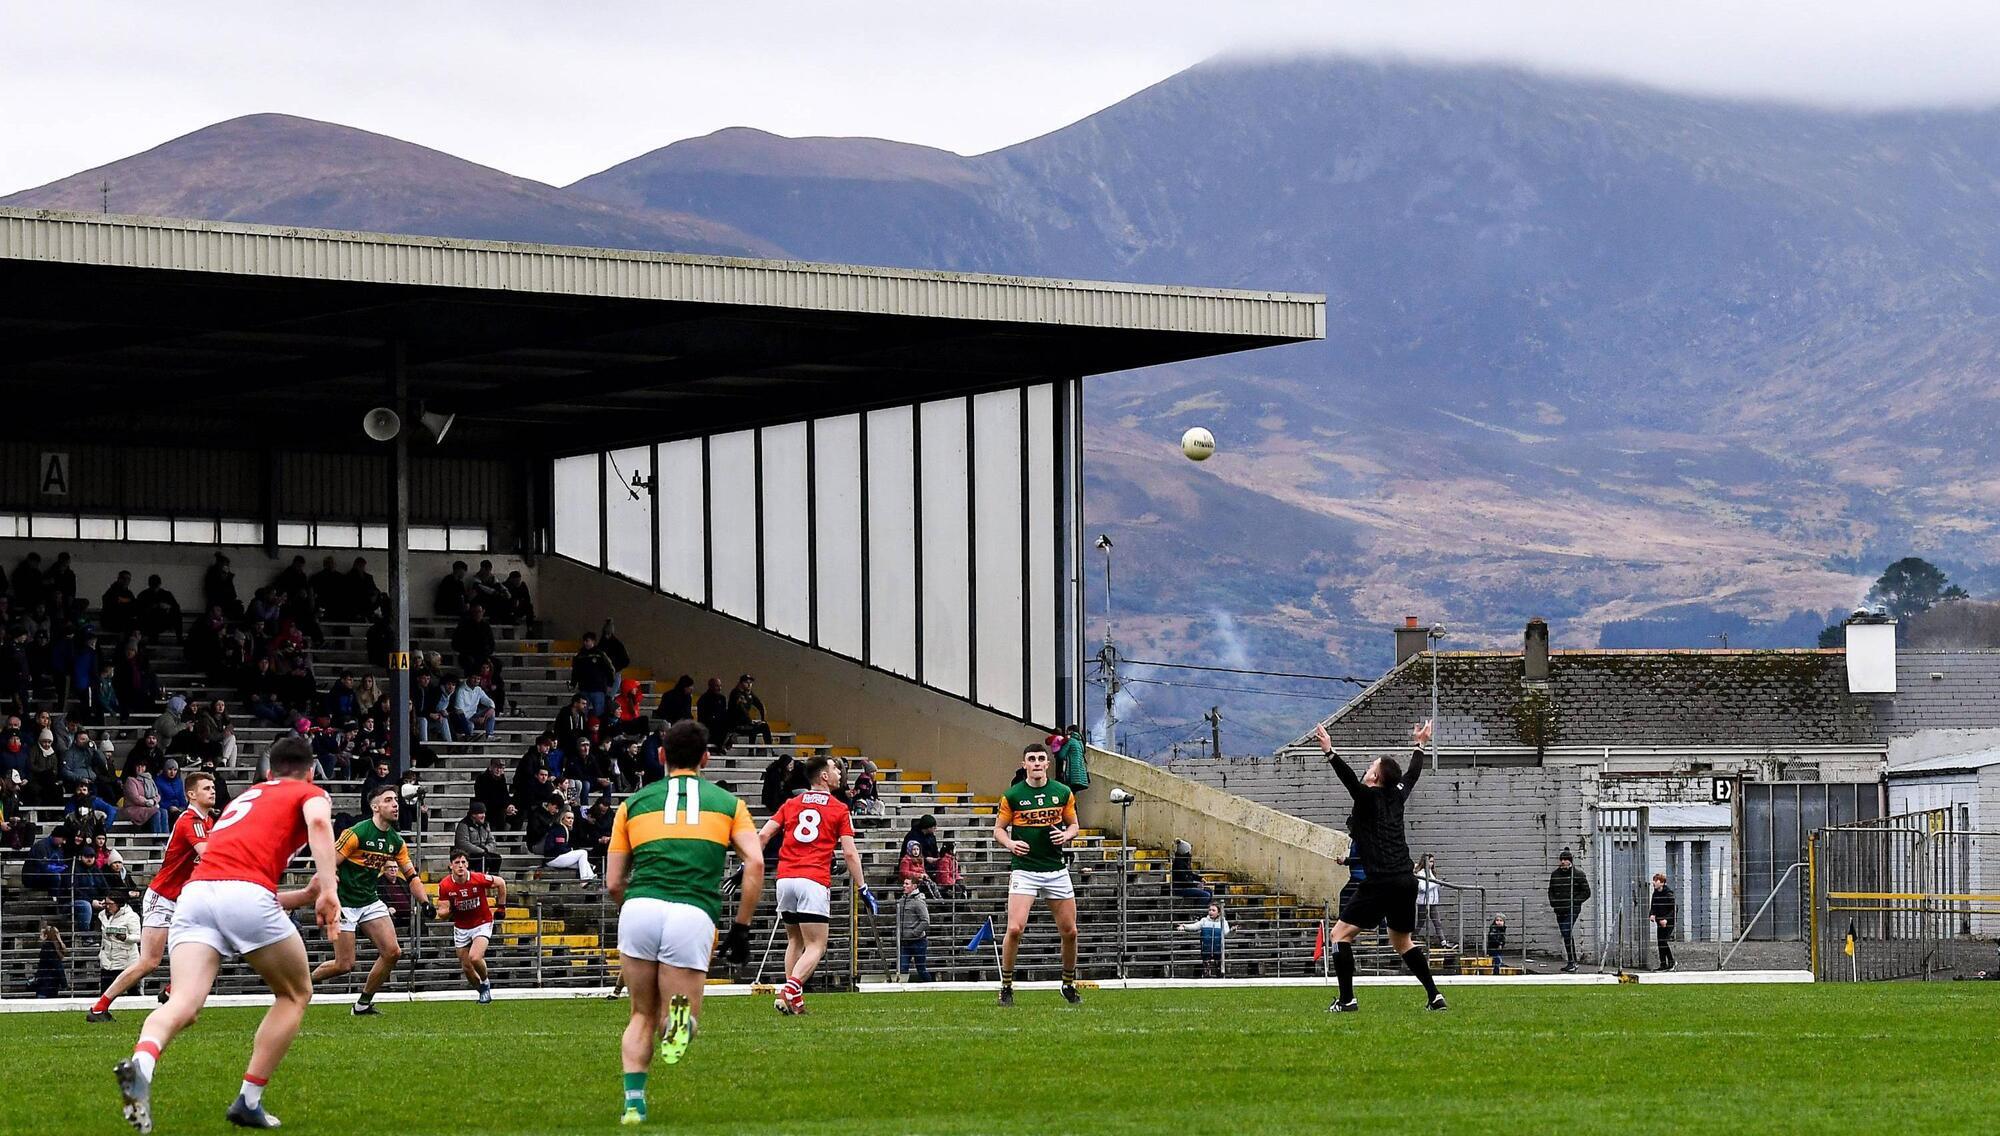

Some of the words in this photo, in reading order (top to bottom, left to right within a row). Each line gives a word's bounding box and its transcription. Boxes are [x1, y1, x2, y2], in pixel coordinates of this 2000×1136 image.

[42, 455, 66, 492] A
[664, 777, 699, 825] 11
[1020, 809, 1062, 819] KERRY
[793, 809, 821, 843] 8
